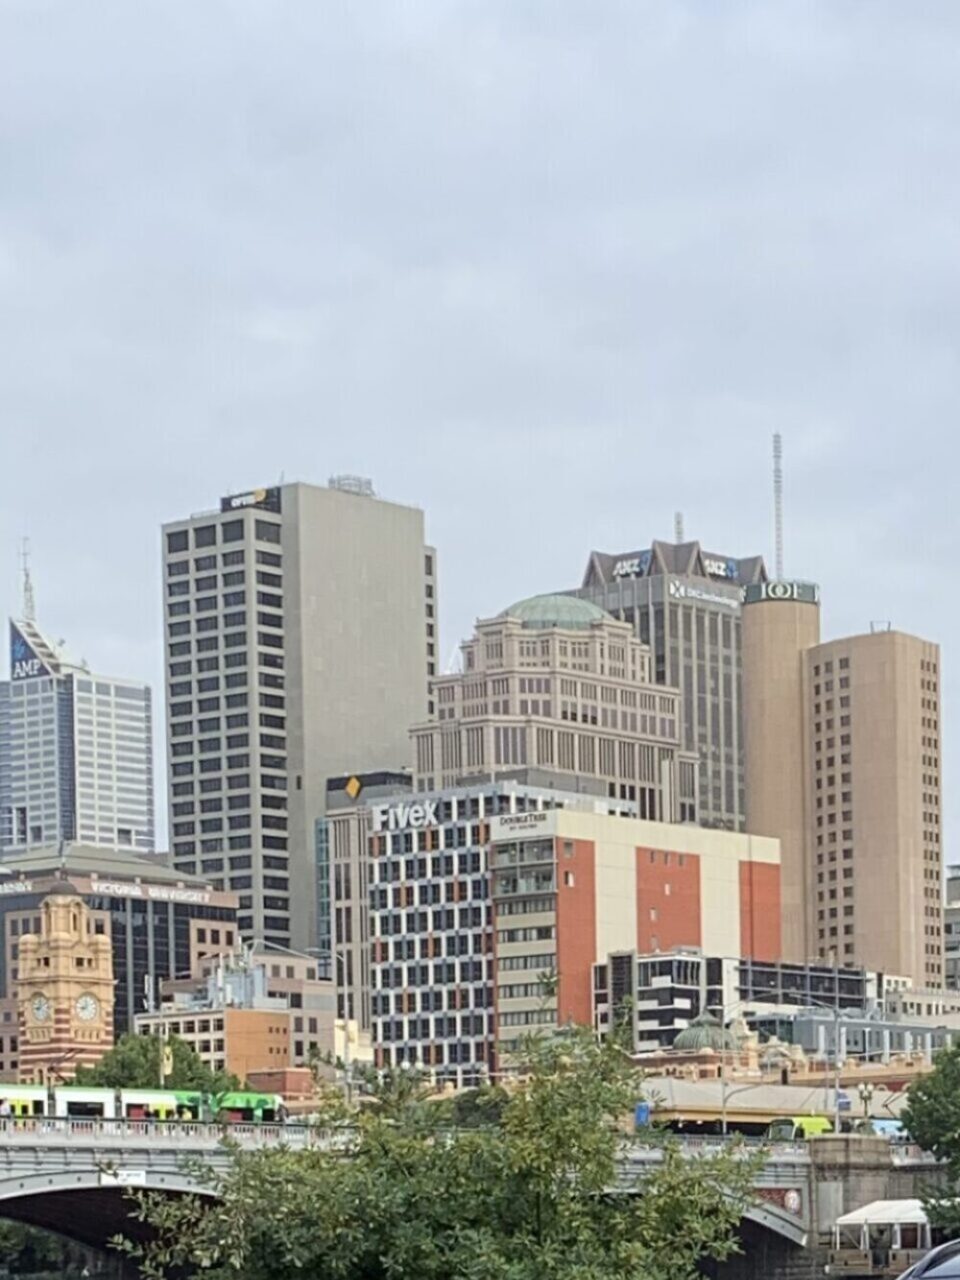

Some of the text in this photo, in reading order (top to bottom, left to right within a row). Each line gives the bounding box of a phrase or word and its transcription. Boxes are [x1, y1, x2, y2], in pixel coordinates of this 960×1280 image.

[612, 559, 640, 576] ANZ
[704, 559, 726, 576] ANZ
[13, 659, 42, 678] AMP
[91, 881, 142, 896] VICTORIA
